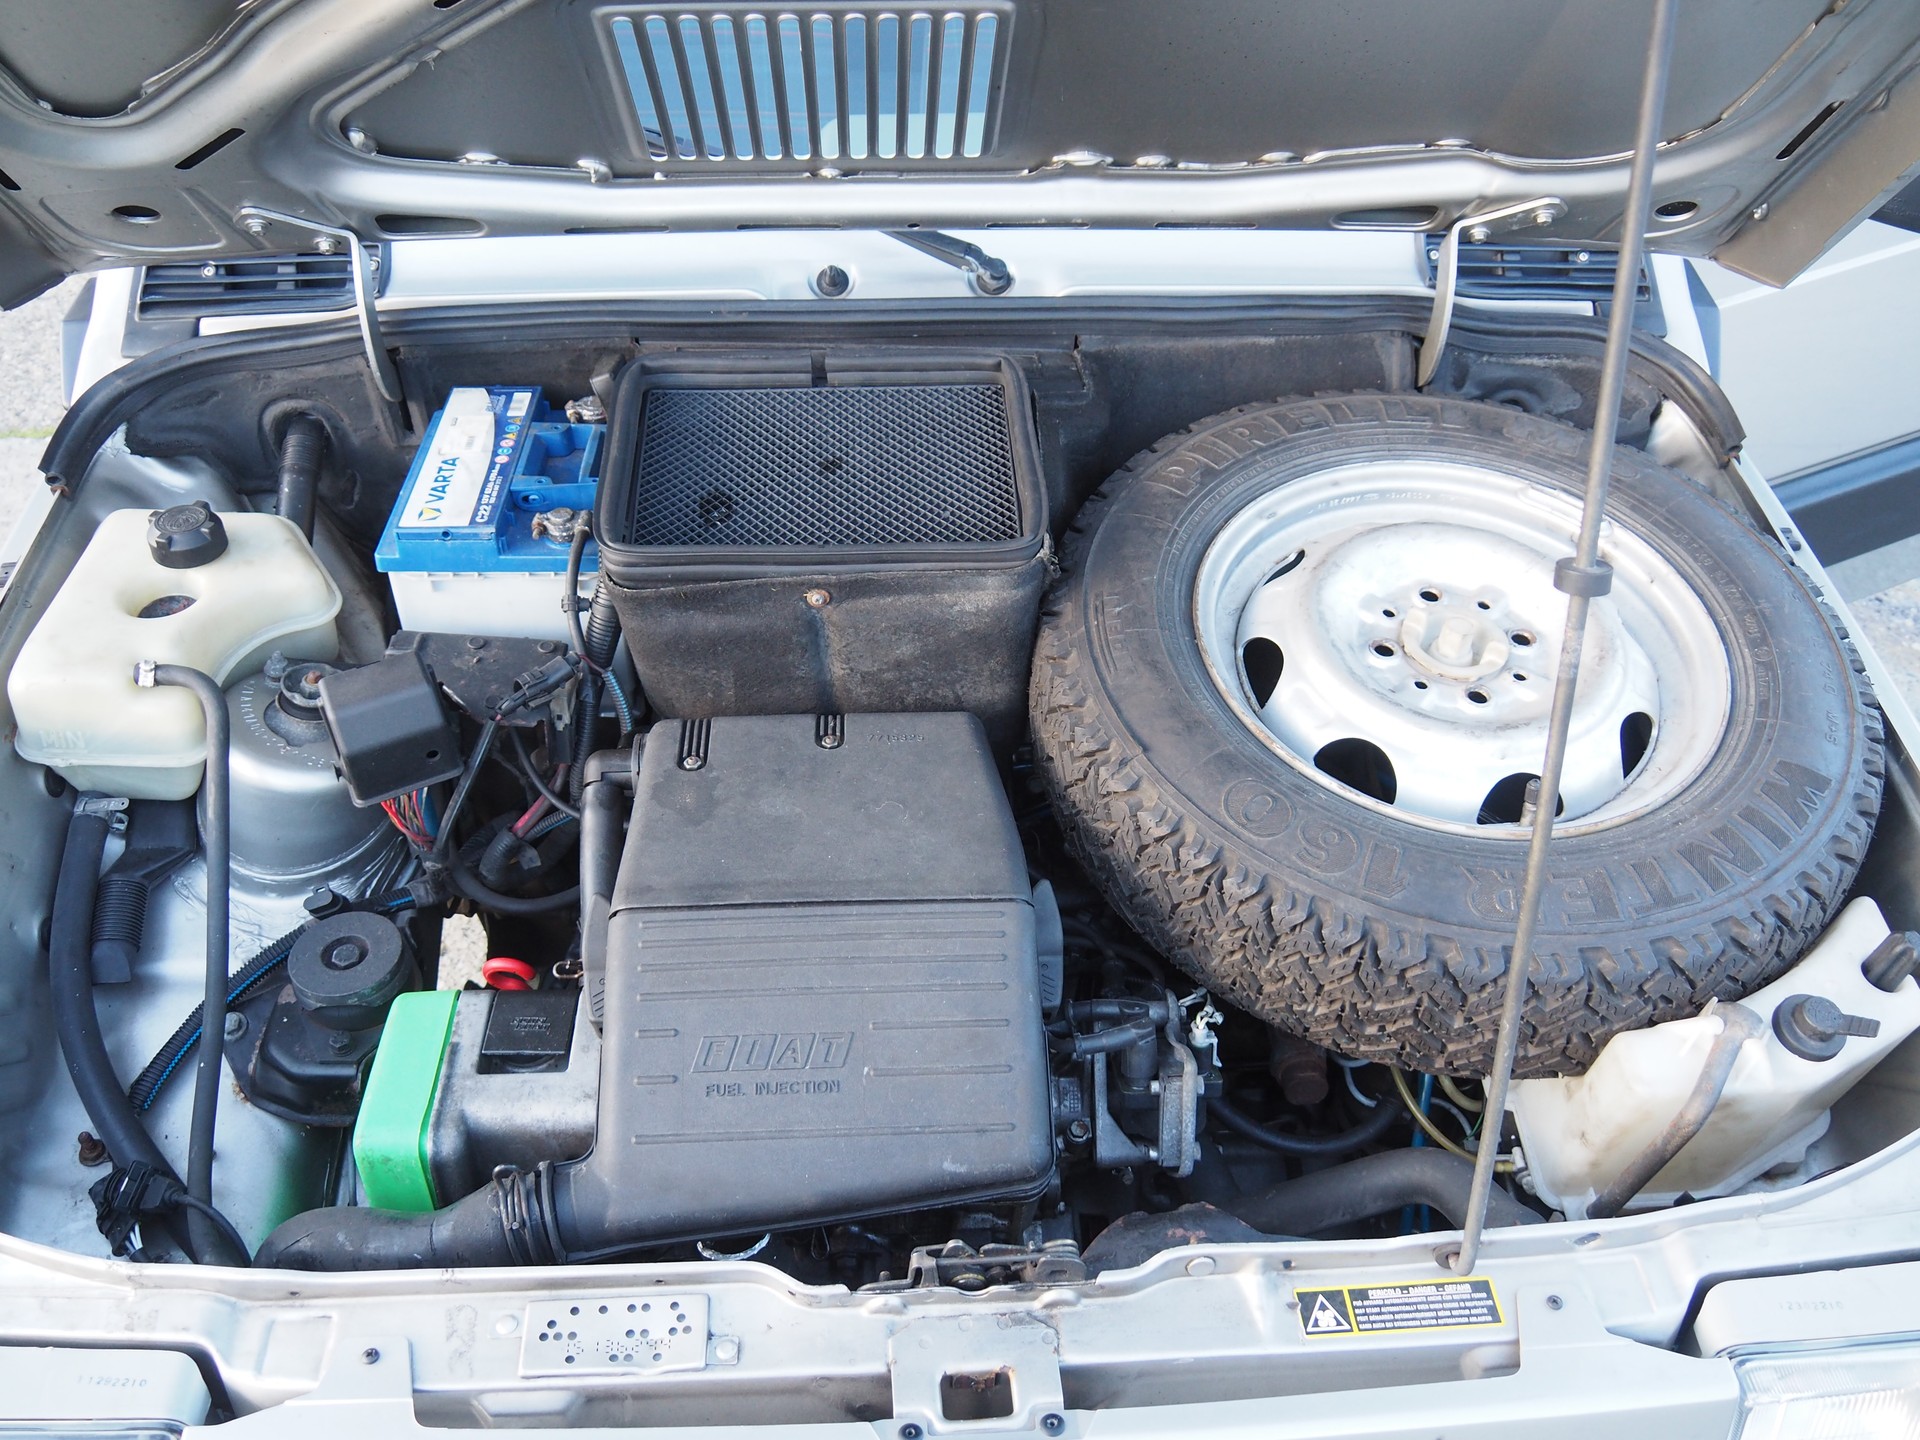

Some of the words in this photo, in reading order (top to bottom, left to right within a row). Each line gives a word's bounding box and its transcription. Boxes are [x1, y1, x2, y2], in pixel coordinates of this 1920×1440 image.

[1143, 398, 1470, 496] PIRELLI
[425, 456, 460, 505] VARTA
[475, 504, 492, 523] C22
[39, 729, 87, 748] MIN
[1221, 777, 1409, 898] 160
[1458, 757, 1834, 926] WINTER
[694, 1033, 851, 1071] FIAT
[705, 1082, 747, 1098] FUEL
[754, 1079, 841, 1096] INJECTION
[1368, 1288, 1402, 1296] PERICOLO
[1408, 1286, 1438, 1294] DANGER
[1444, 1283, 1472, 1291] GEFAHR
